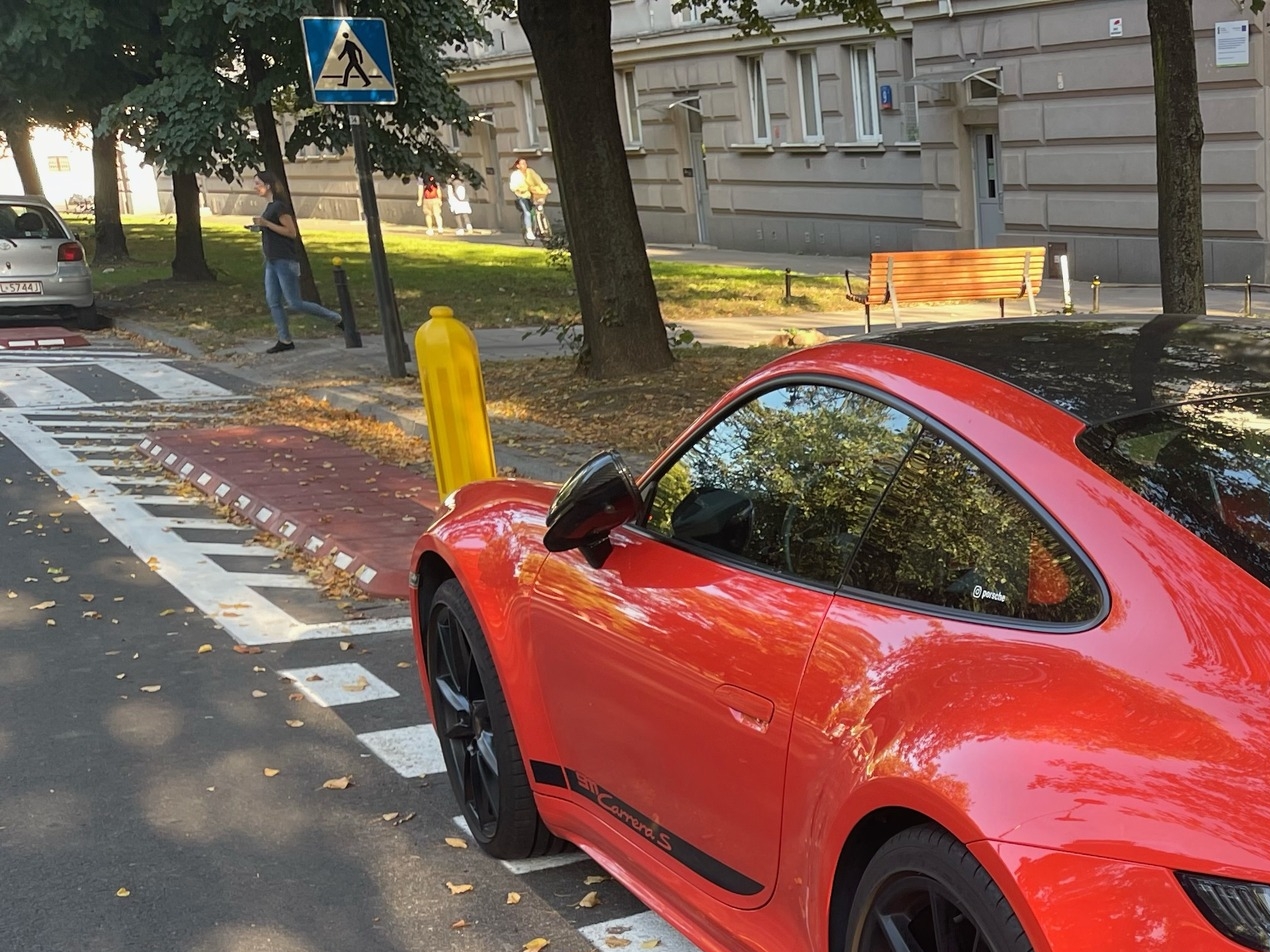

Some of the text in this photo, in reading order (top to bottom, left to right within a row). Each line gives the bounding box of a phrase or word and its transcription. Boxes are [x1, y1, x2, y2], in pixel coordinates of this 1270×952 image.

[981, 590, 1006, 602] porsche
[575, 771, 672, 851] 911 Carrera S
